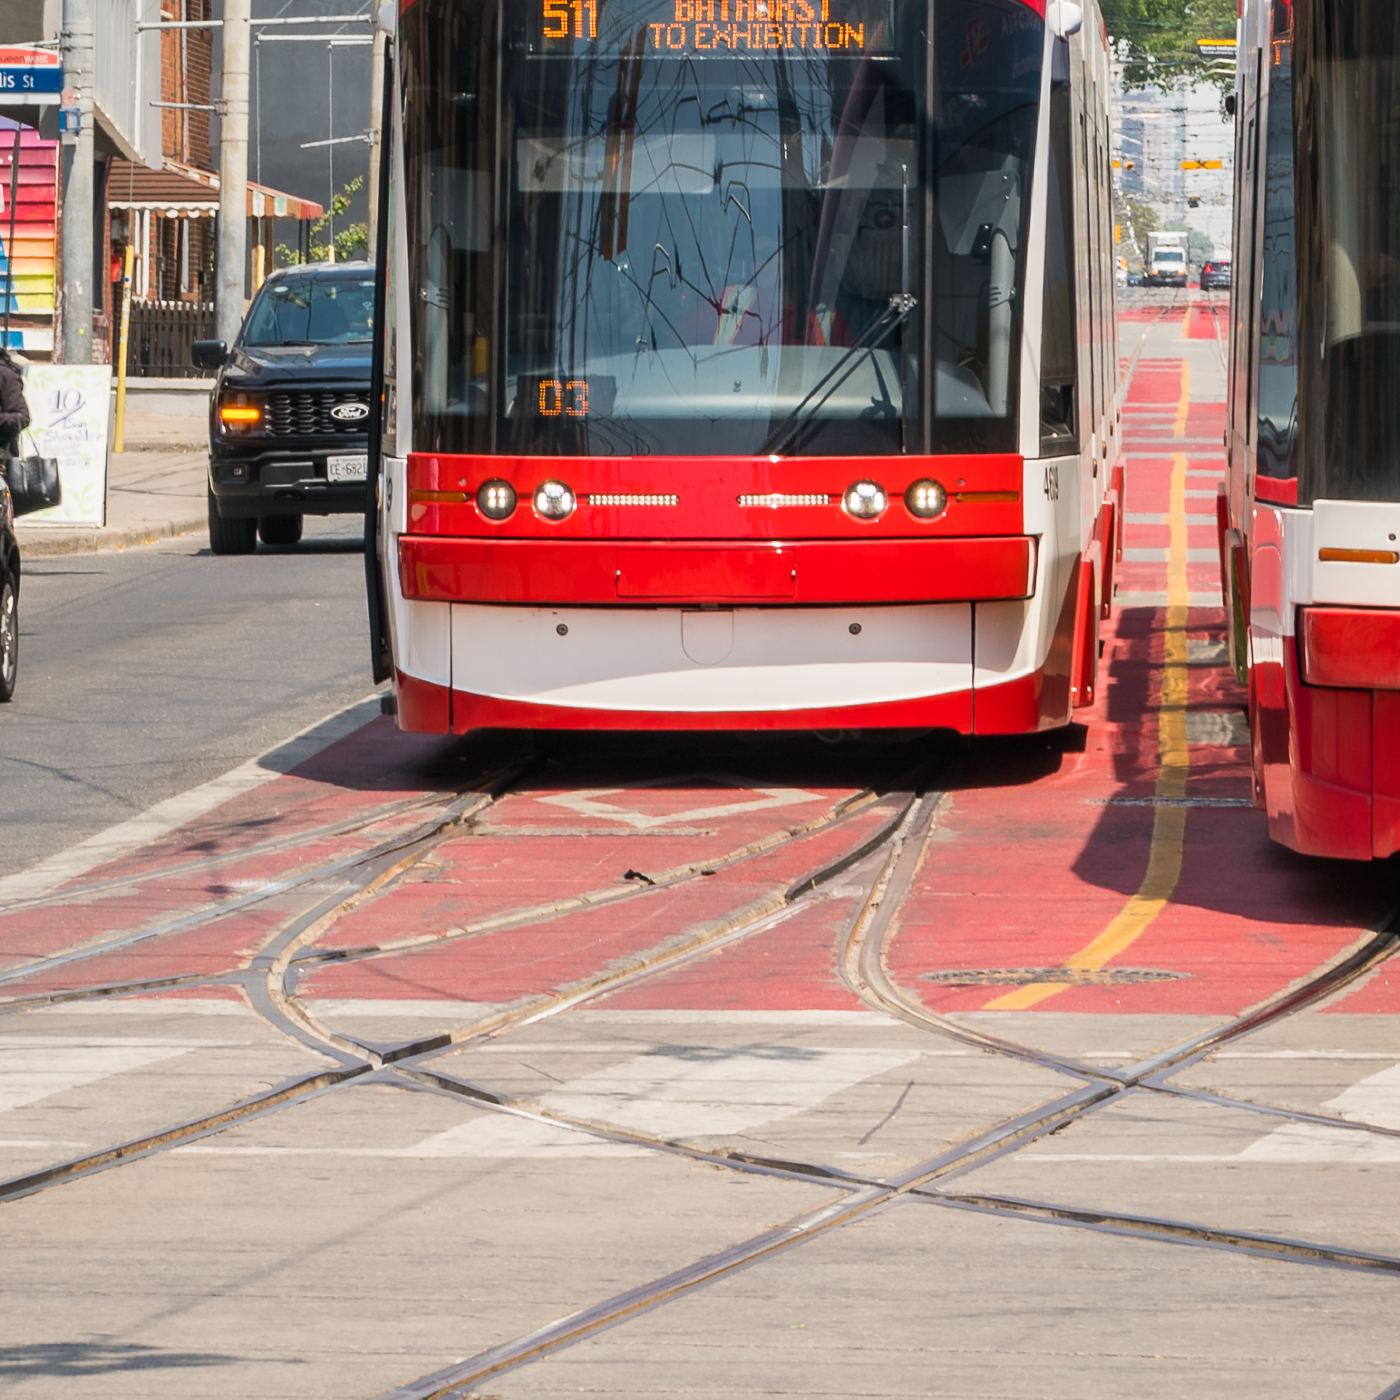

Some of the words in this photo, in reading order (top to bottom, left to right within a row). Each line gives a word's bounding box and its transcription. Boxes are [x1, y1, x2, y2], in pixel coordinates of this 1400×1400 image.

[650, 23, 683, 49] TO
[694, 23, 864, 49] EXHIBITION
[23, 75, 35, 88] St
[539, 380, 589, 416] 03
[338, 408, 361, 419] Ford
